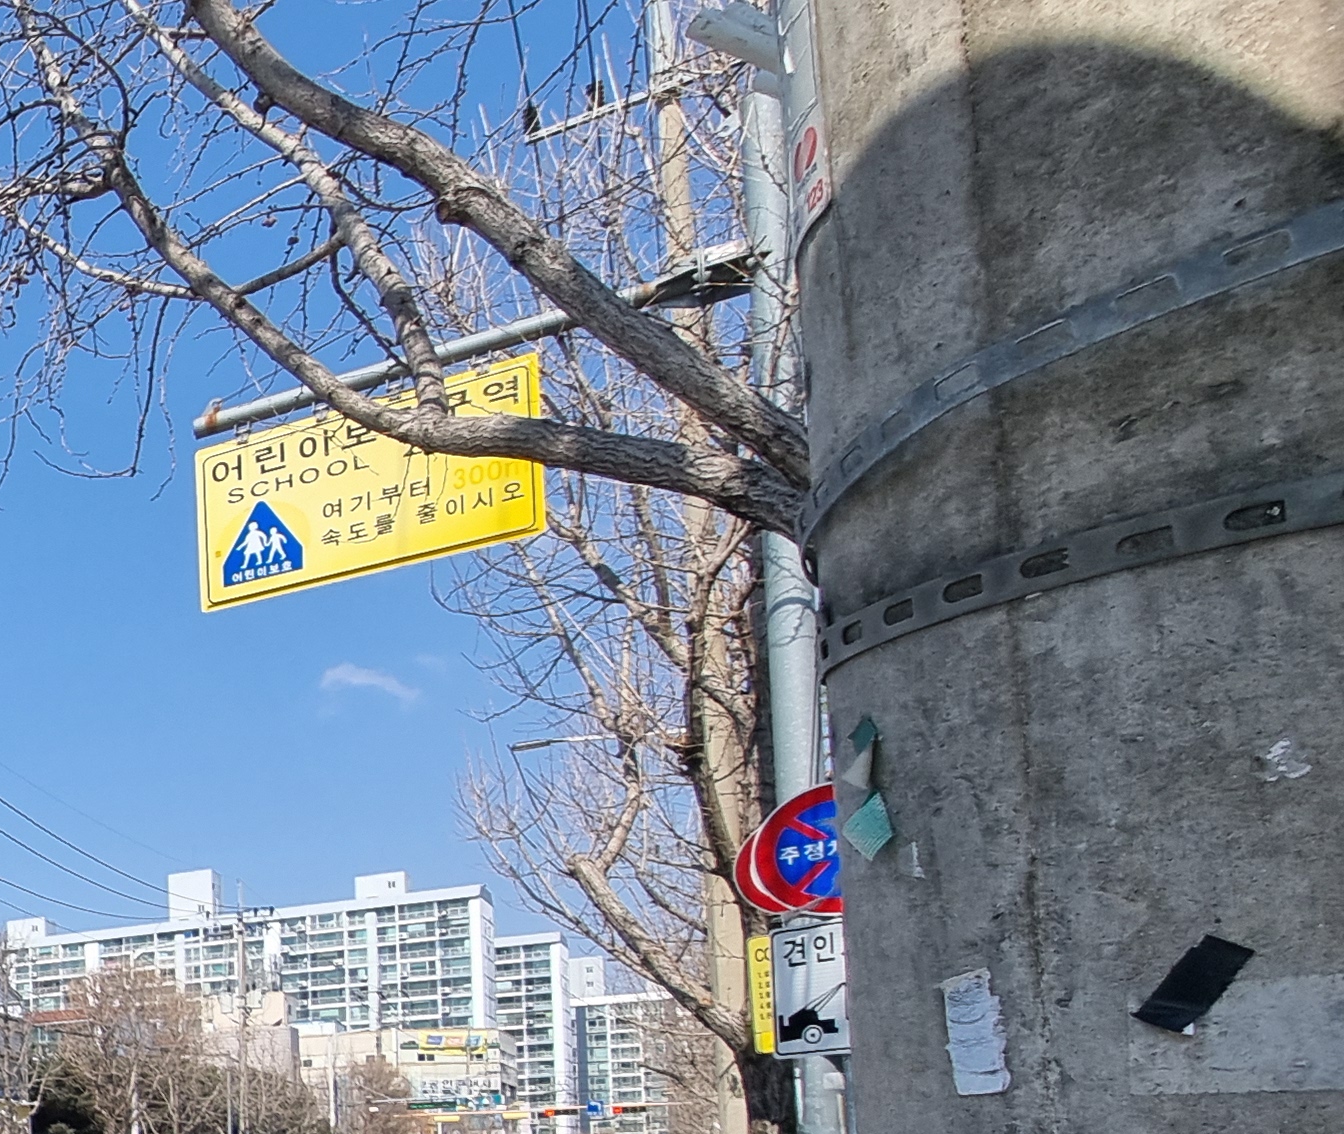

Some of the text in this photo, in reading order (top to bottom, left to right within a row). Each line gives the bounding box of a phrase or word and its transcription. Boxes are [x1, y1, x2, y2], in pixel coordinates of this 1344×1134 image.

[228, 454, 370, 505] SCHOOL
[322, 476, 433, 519] 여기부터
[321, 481, 526, 547] 속도를 줄이시오
[231, 561, 293, 583] 어린이보호
